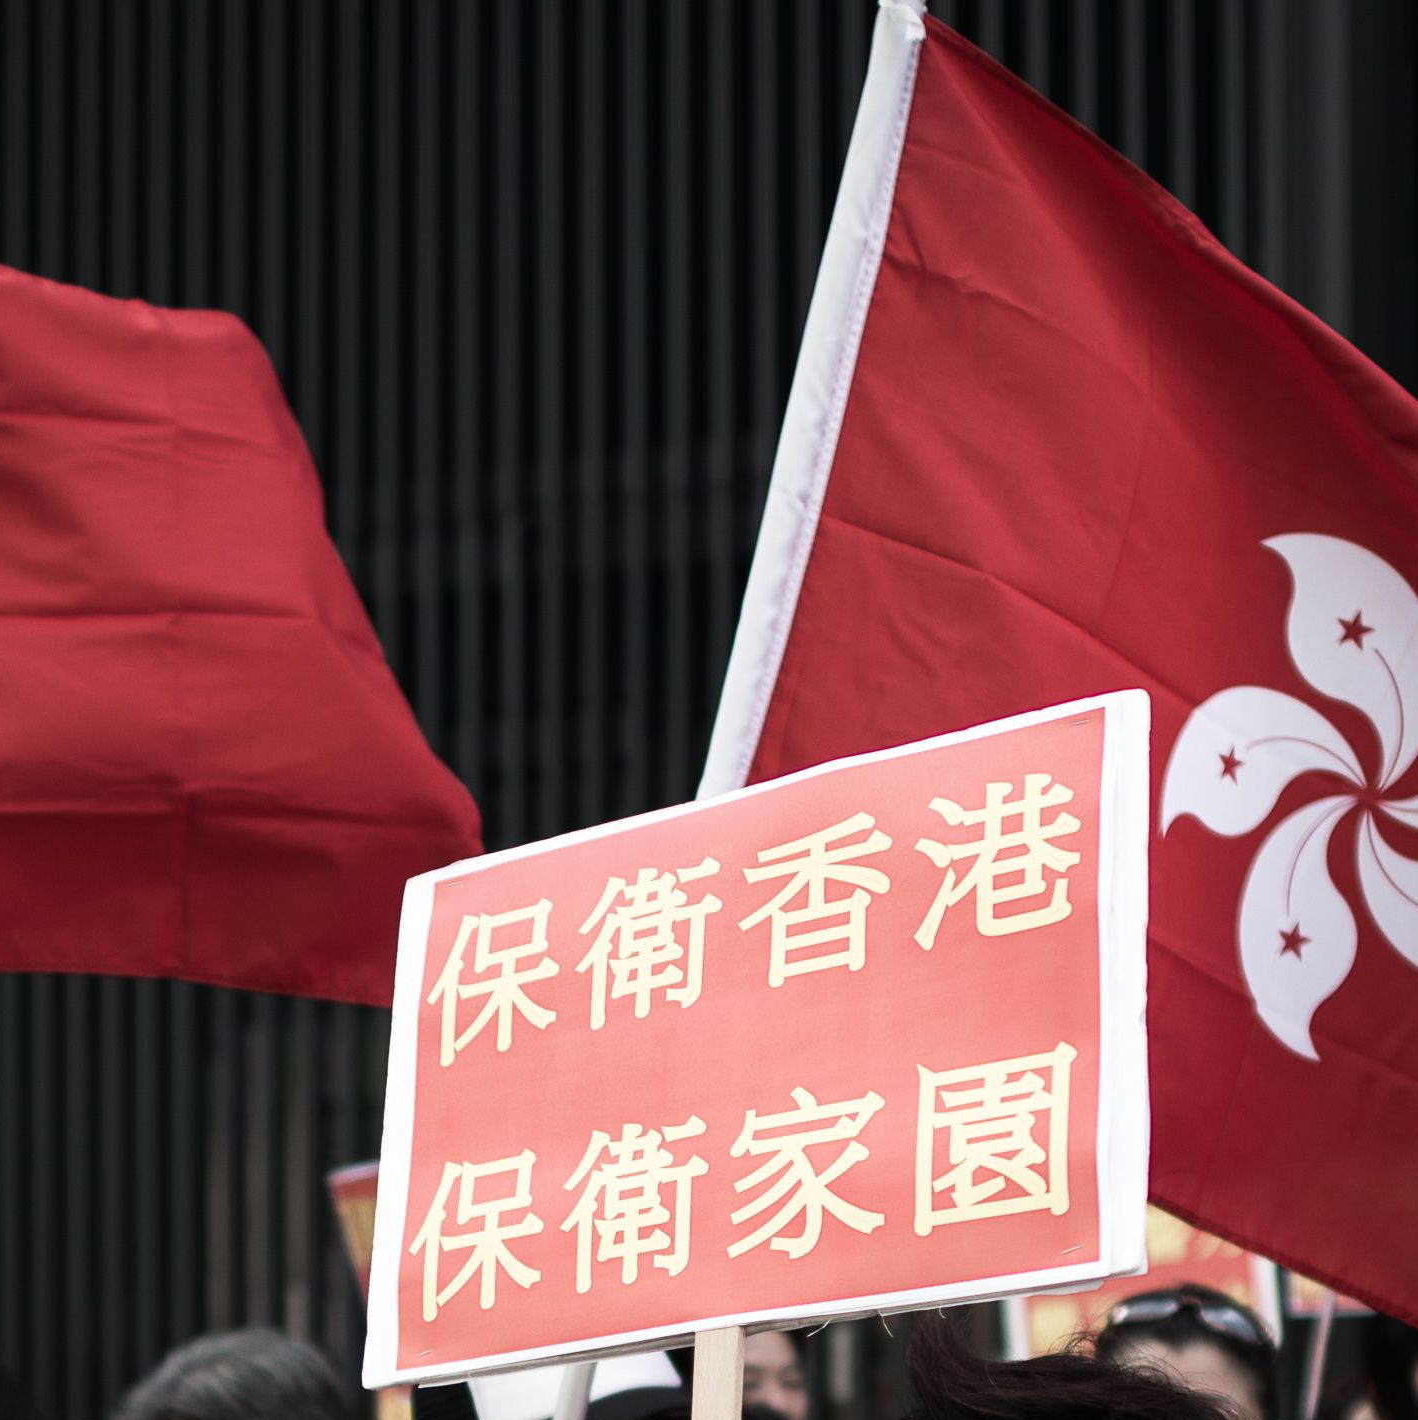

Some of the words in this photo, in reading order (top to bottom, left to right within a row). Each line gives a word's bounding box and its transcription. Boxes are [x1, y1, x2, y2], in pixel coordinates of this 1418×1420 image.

[426, 772, 1083, 1068] 保衛香港
[408, 1040, 1078, 1323] 保衛家園
